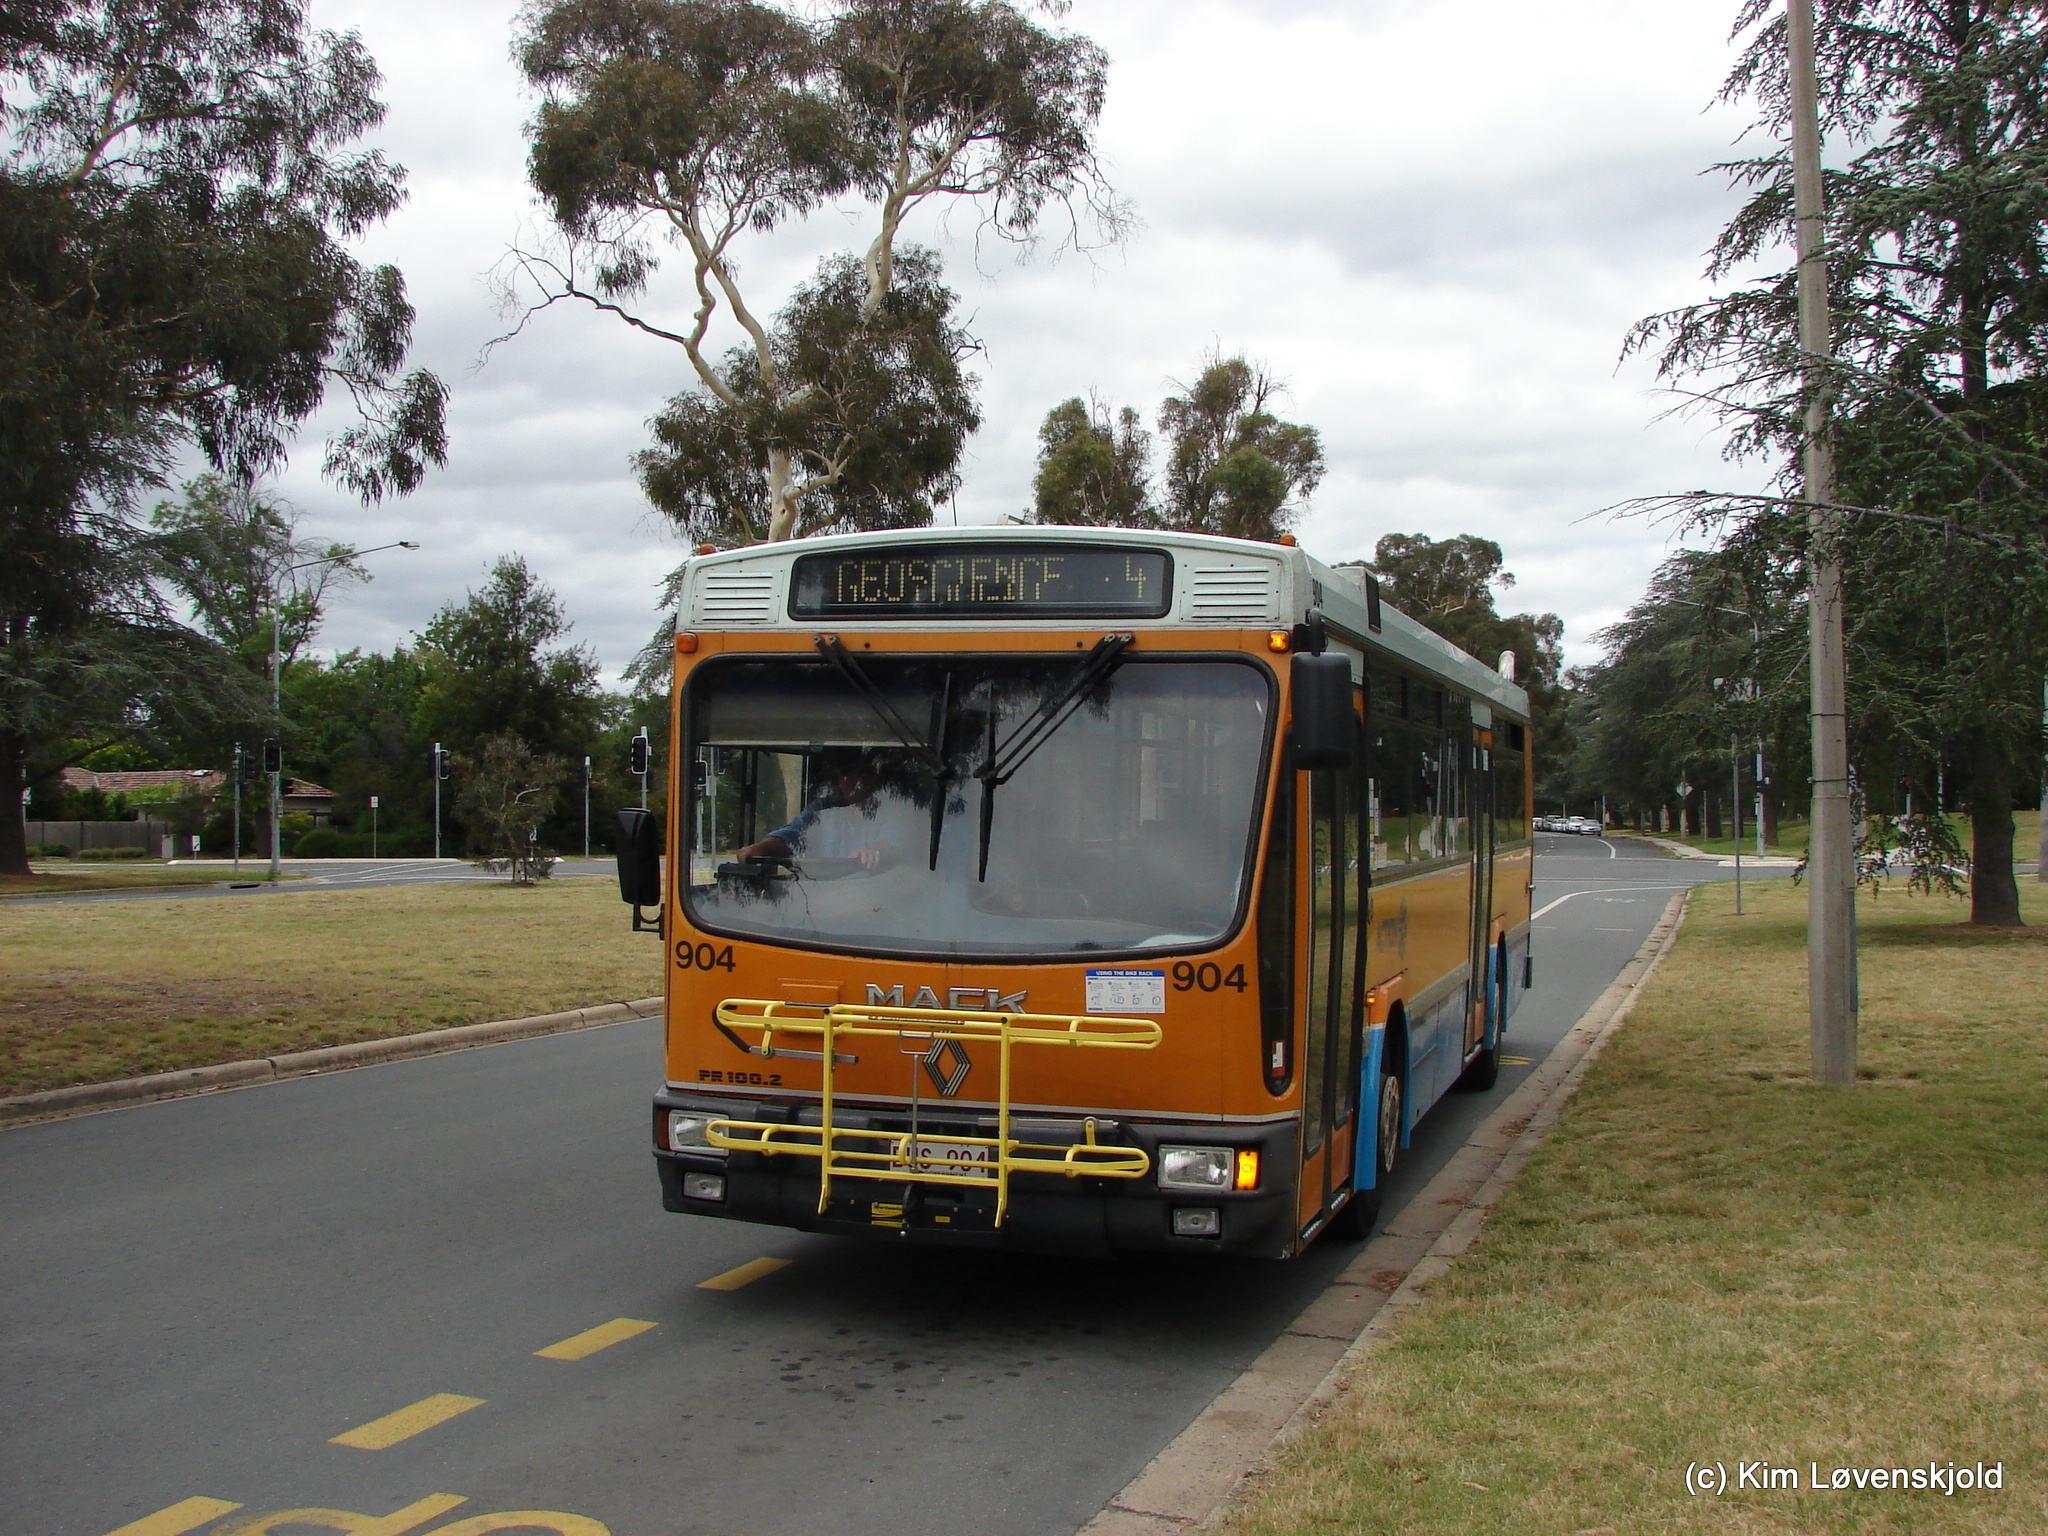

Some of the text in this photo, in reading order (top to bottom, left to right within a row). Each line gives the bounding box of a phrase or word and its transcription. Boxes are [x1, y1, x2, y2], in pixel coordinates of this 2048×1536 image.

[1125, 556, 1148, 599] 4
[675, 940, 737, 973] 904
[1172, 960, 1248, 993] 904
[865, 983, 1028, 1013] MACK
[698, 1069, 783, 1086] PR 100.2
[946, 1149, 986, 1173] 904
